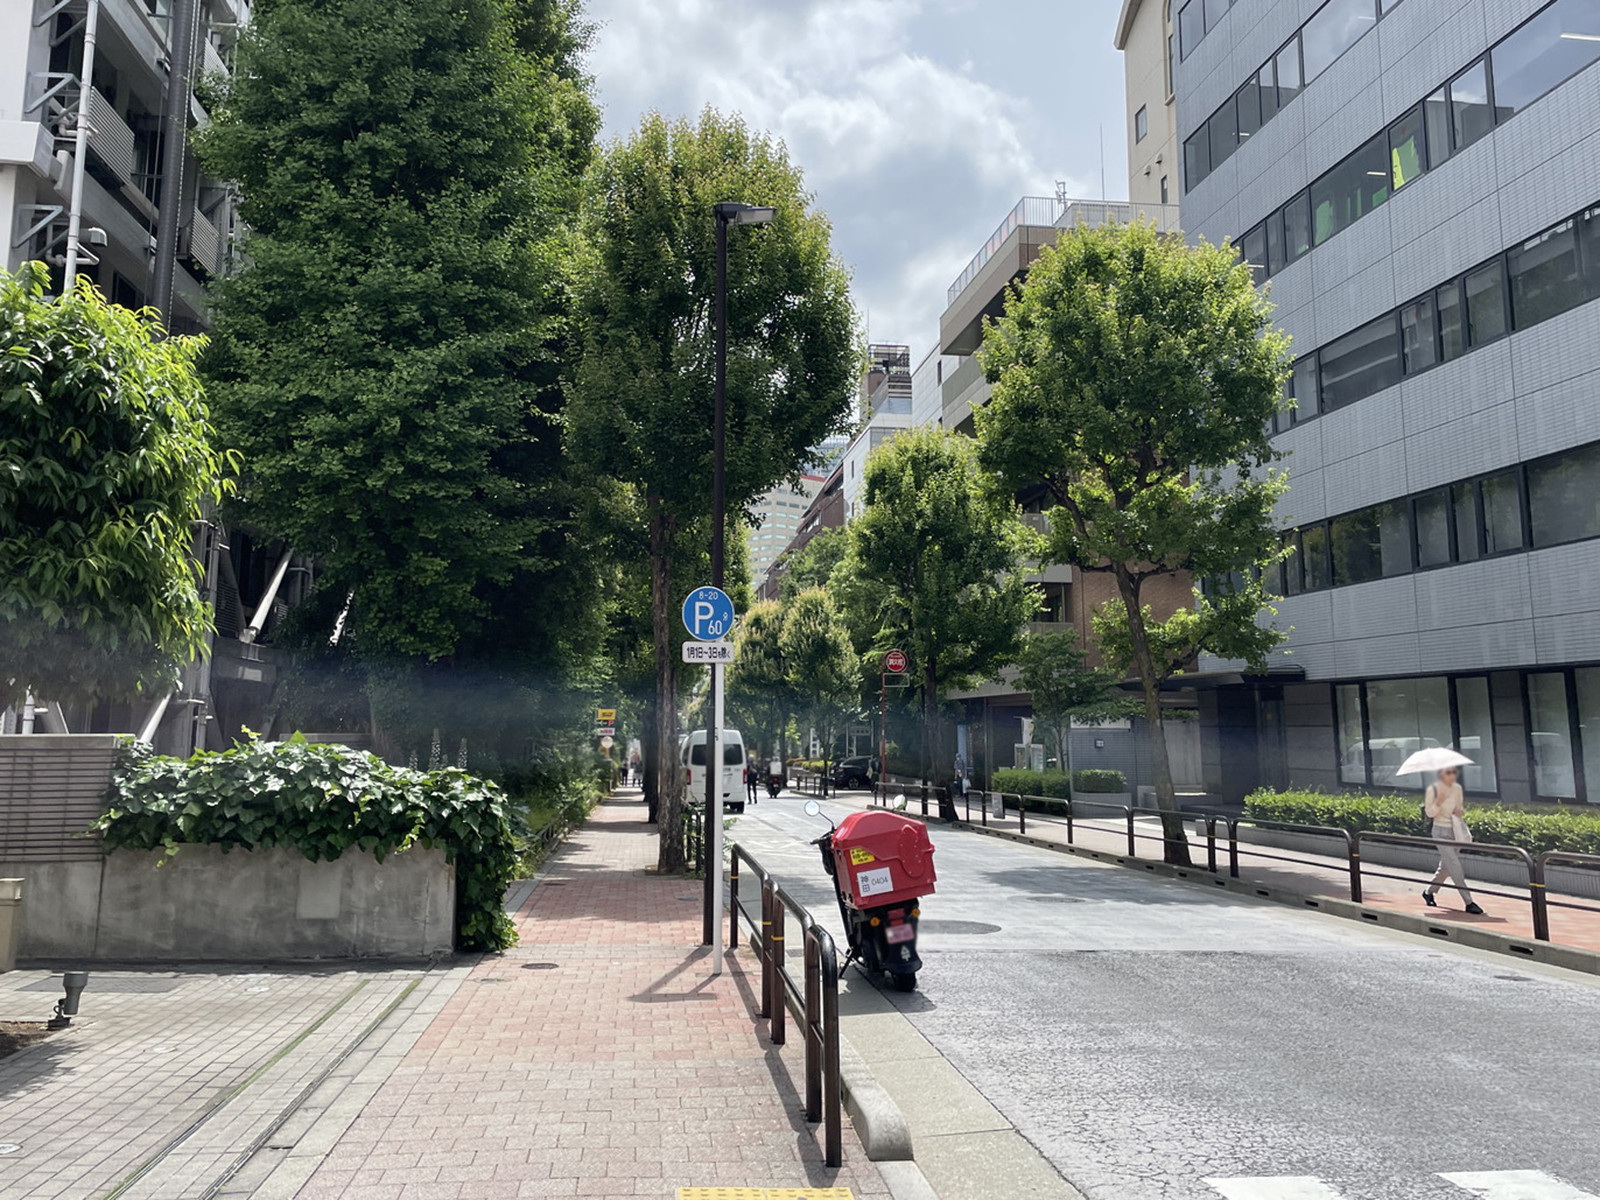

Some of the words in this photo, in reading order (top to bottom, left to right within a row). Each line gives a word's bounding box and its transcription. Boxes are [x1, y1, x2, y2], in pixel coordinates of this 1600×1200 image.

[699, 591, 718, 600] 8-20
[694, 601, 714, 635] P
[708, 620, 722, 635] 60
[871, 876, 888, 886] 0404
